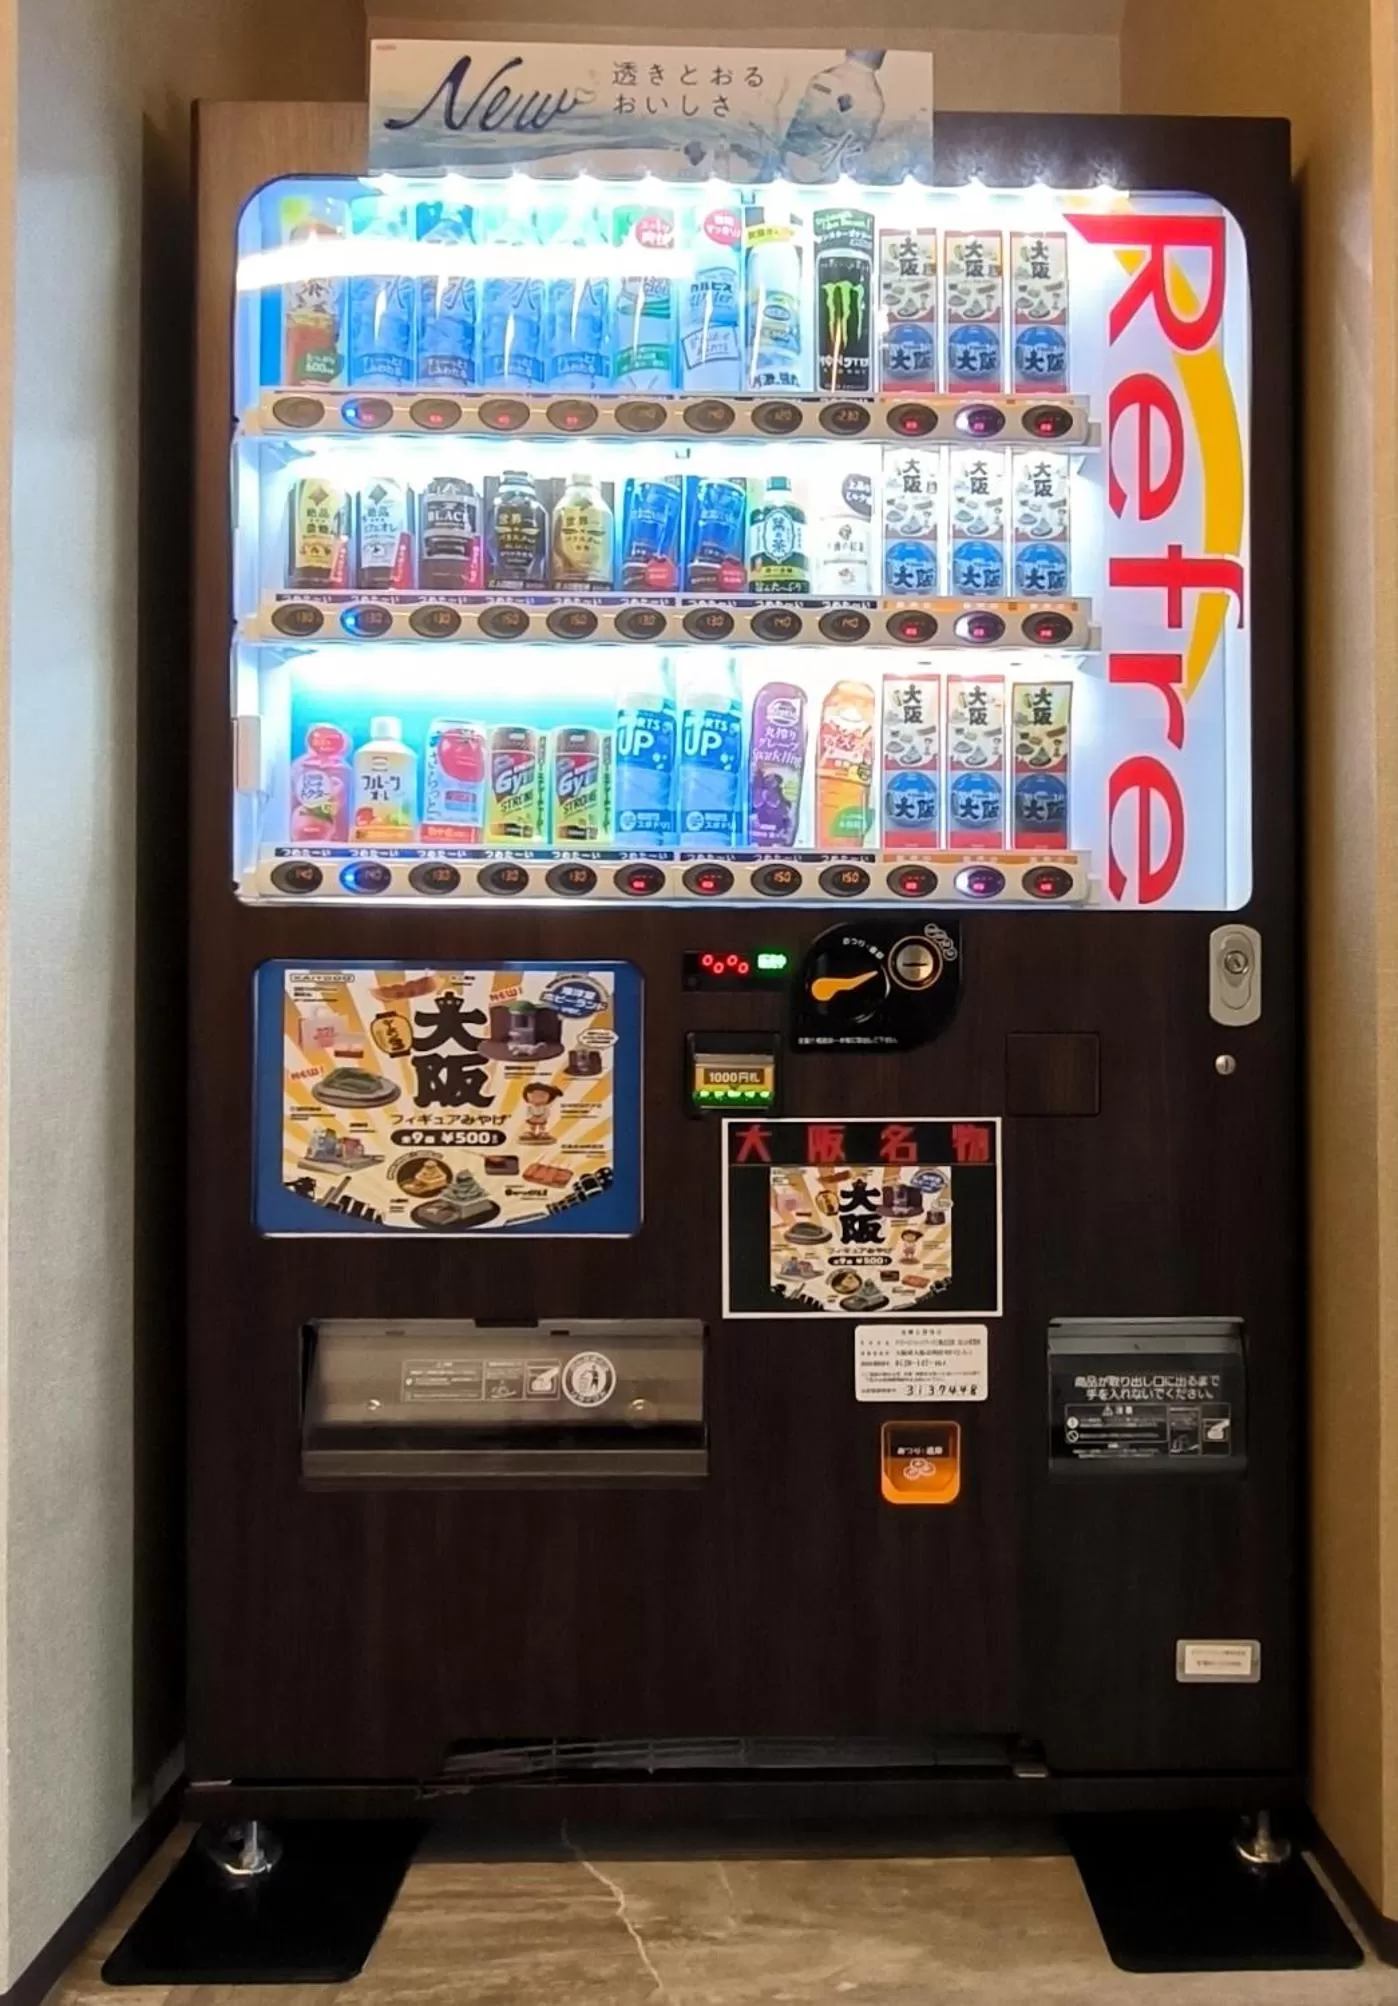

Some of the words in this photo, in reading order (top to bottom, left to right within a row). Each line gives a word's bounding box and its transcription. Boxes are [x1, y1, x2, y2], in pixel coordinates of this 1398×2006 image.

[612, 61, 764, 88] 透きとおる
[383, 55, 594, 132] New
[612, 93, 732, 117] おいしさ
[900, 236, 920, 276] 大阪
[965, 240, 985, 278] 大阪
[1031, 240, 1051, 279] 大阪
[892, 349, 933, 371] 大阪
[957, 350, 997, 371] 大阪
[1025, 350, 1065, 373] 大阪
[902, 458, 922, 493] 大阪
[970, 460, 989, 495] 大阪
[1033, 461, 1054, 497] 大阪
[1063, 214, 1244, 904] Refre
[894, 564, 934, 588] 大阪
[962, 565, 1001, 589] 大阪
[1025, 568, 1066, 590] 大阪
[903, 684, 923, 724] 大阪
[969, 685, 988, 726] 大阪
[1033, 687, 1053, 726] 大阪
[618, 728, 655, 757] UP
[684, 726, 722, 757] UP
[895, 797, 935, 819] 大阪
[960, 797, 1000, 820] 大阪
[413, 991, 496, 1108] 大阪
[391, 1113, 513, 1126] フィギュアみやげ
[441, 1131, 491, 1145] ¥500
[735, 1124, 991, 1163] 大阪名物
[838, 1179, 886, 1245] 大阪
[1074, 1375, 1221, 1388] 商品が取り出し口に出るまで
[1086, 1388, 1215, 1401] 手を入れないでください
